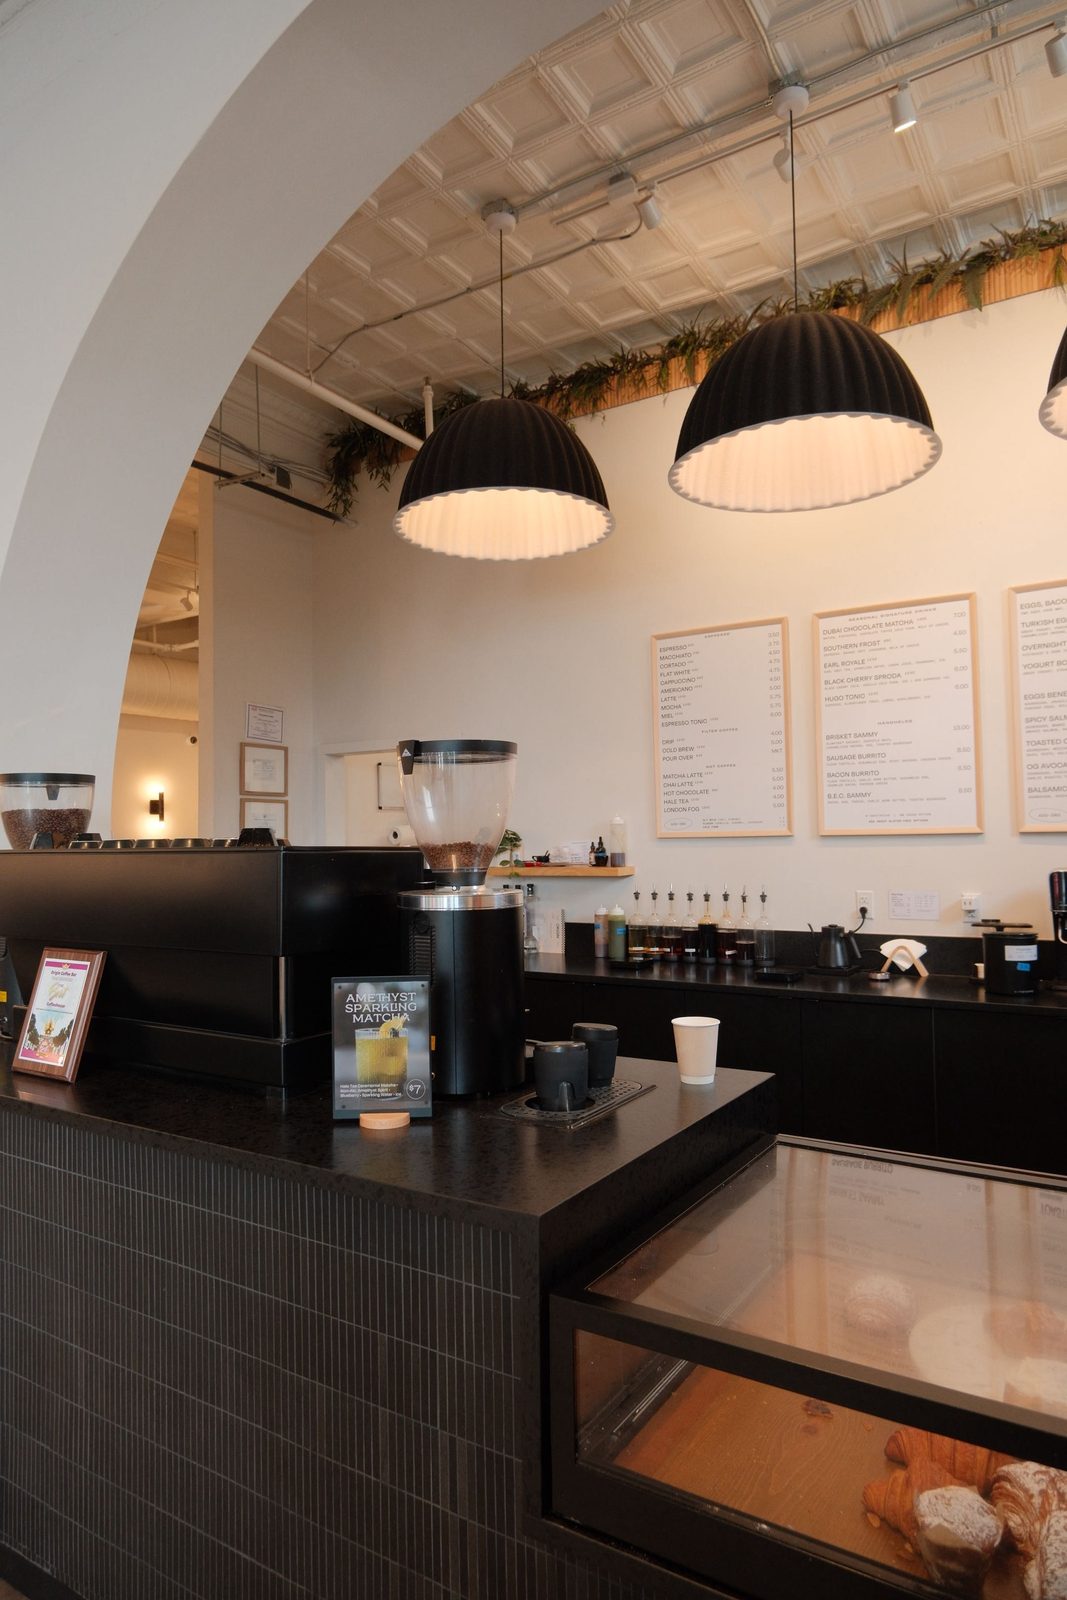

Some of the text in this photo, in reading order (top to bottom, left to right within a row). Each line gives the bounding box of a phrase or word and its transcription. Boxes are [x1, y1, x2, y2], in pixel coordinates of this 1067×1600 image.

[822, 627, 843, 635] DUBAI
[843, 622, 884, 632] CHOCOLATE
[884, 619, 914, 627] MATCHA
[1021, 618, 1055, 628] TURKISH
[659, 644, 687, 652] ESPRESSO
[823, 643, 859, 653] SOUTHERN
[859, 640, 881, 648] FROST
[1022, 640, 1067, 651] OVERNIGHT
[659, 652, 692, 660] MACCHIATO
[659, 661, 687, 669] CORTADO
[823, 662, 841, 670] EARL
[841, 658, 866, 667] ROYALE
[1022, 661, 1055, 670] YOGURT
[660, 677, 696, 685] CAPPUCCINO
[823, 678, 846, 686] BLACK
[846, 675, 873, 684] CHERRY
[873, 673, 902, 681] SPRODA
[660, 686, 693, 694] AMERICANO
[824, 695, 845, 703] HUGO
[1024, 716, 1048, 724] SPICY
[825, 733, 852, 741] BRISKET
[1025, 739, 1062, 747] TOASTED
[826, 754, 857, 762] SAUSAGE
[857, 752, 887, 760] BURRITO
[850, 770, 880, 778] BURRITO
[846, 791, 872, 799] SAMMY
[345, 992, 417, 1003] AMETHYST
[344, 1002, 418, 1013] SPARKLING
[352, 1012, 411, 1024] MATCHA
[409, 1084, 421, 1095] $7
